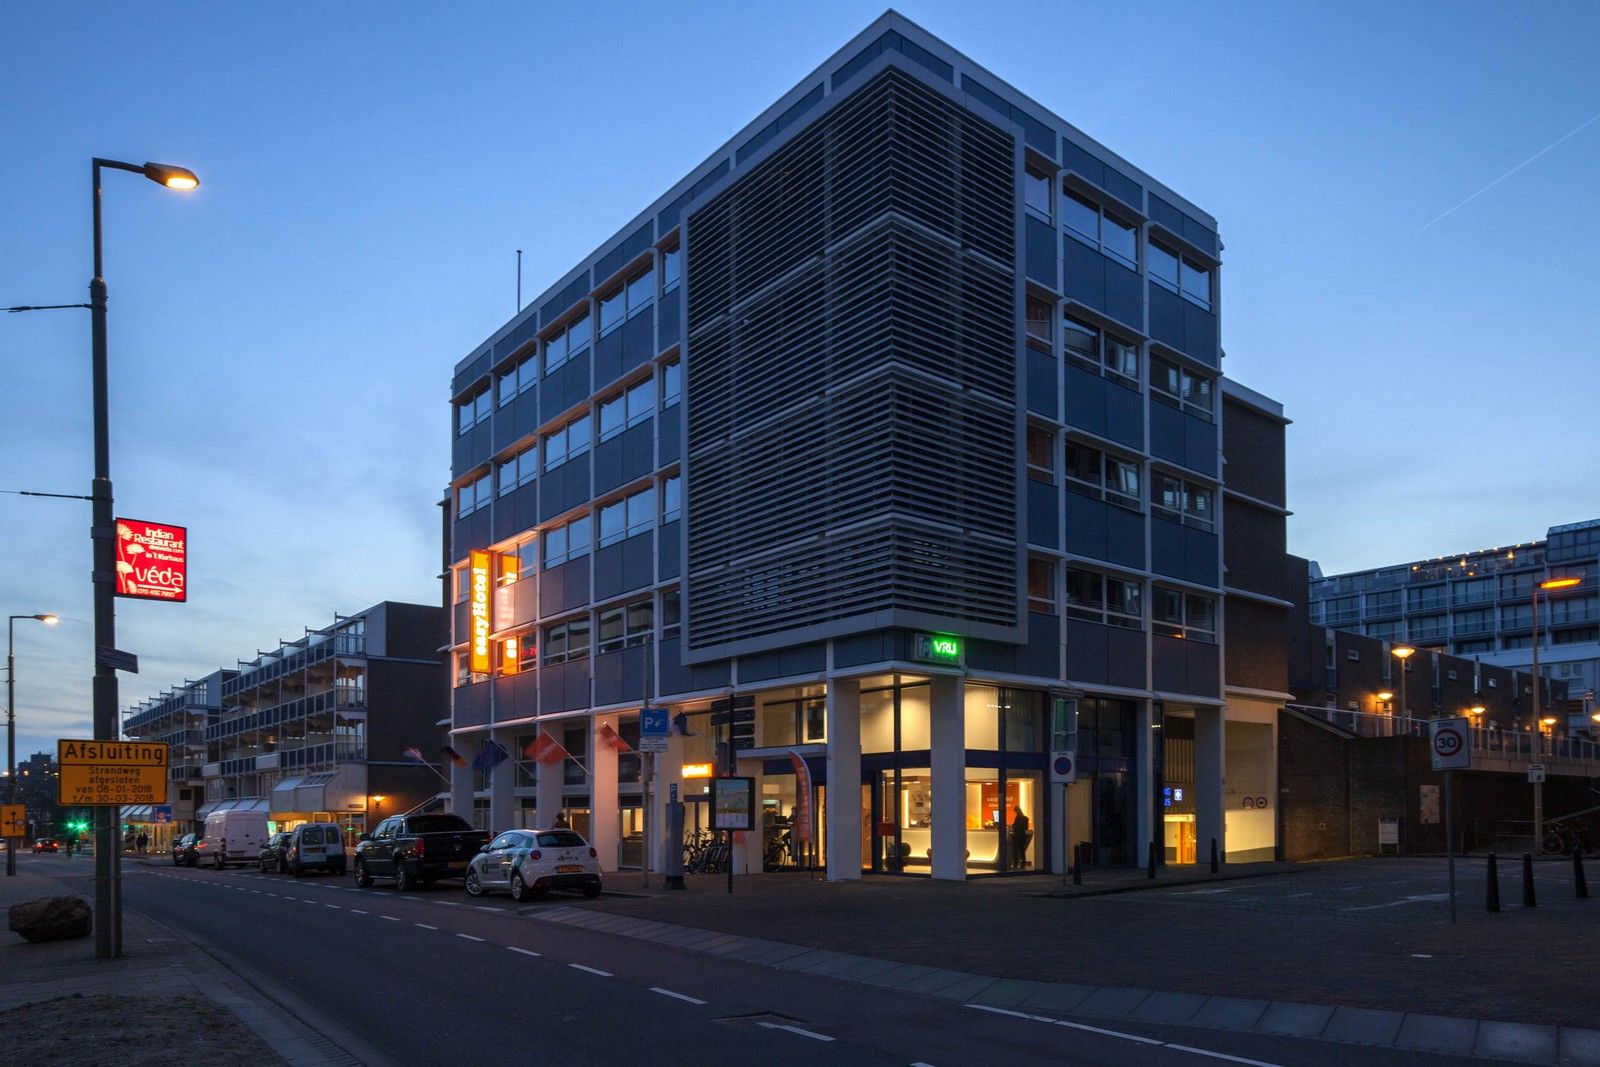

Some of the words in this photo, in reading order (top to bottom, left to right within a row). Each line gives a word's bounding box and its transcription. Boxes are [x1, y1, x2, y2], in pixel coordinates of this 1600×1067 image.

[145, 527, 174, 540] Indian
[133, 533, 184, 549] Restaurant
[135, 566, 184, 587] véda
[472, 567, 489, 656] easyHotel
[645, 717, 654, 728] P
[1438, 737, 1457, 748] 30
[64, 743, 164, 764] Afsluiting
[88, 766, 140, 776] Strandweg
[89, 776, 140, 785] afgesloten
[72, 794, 94, 802] t/m
